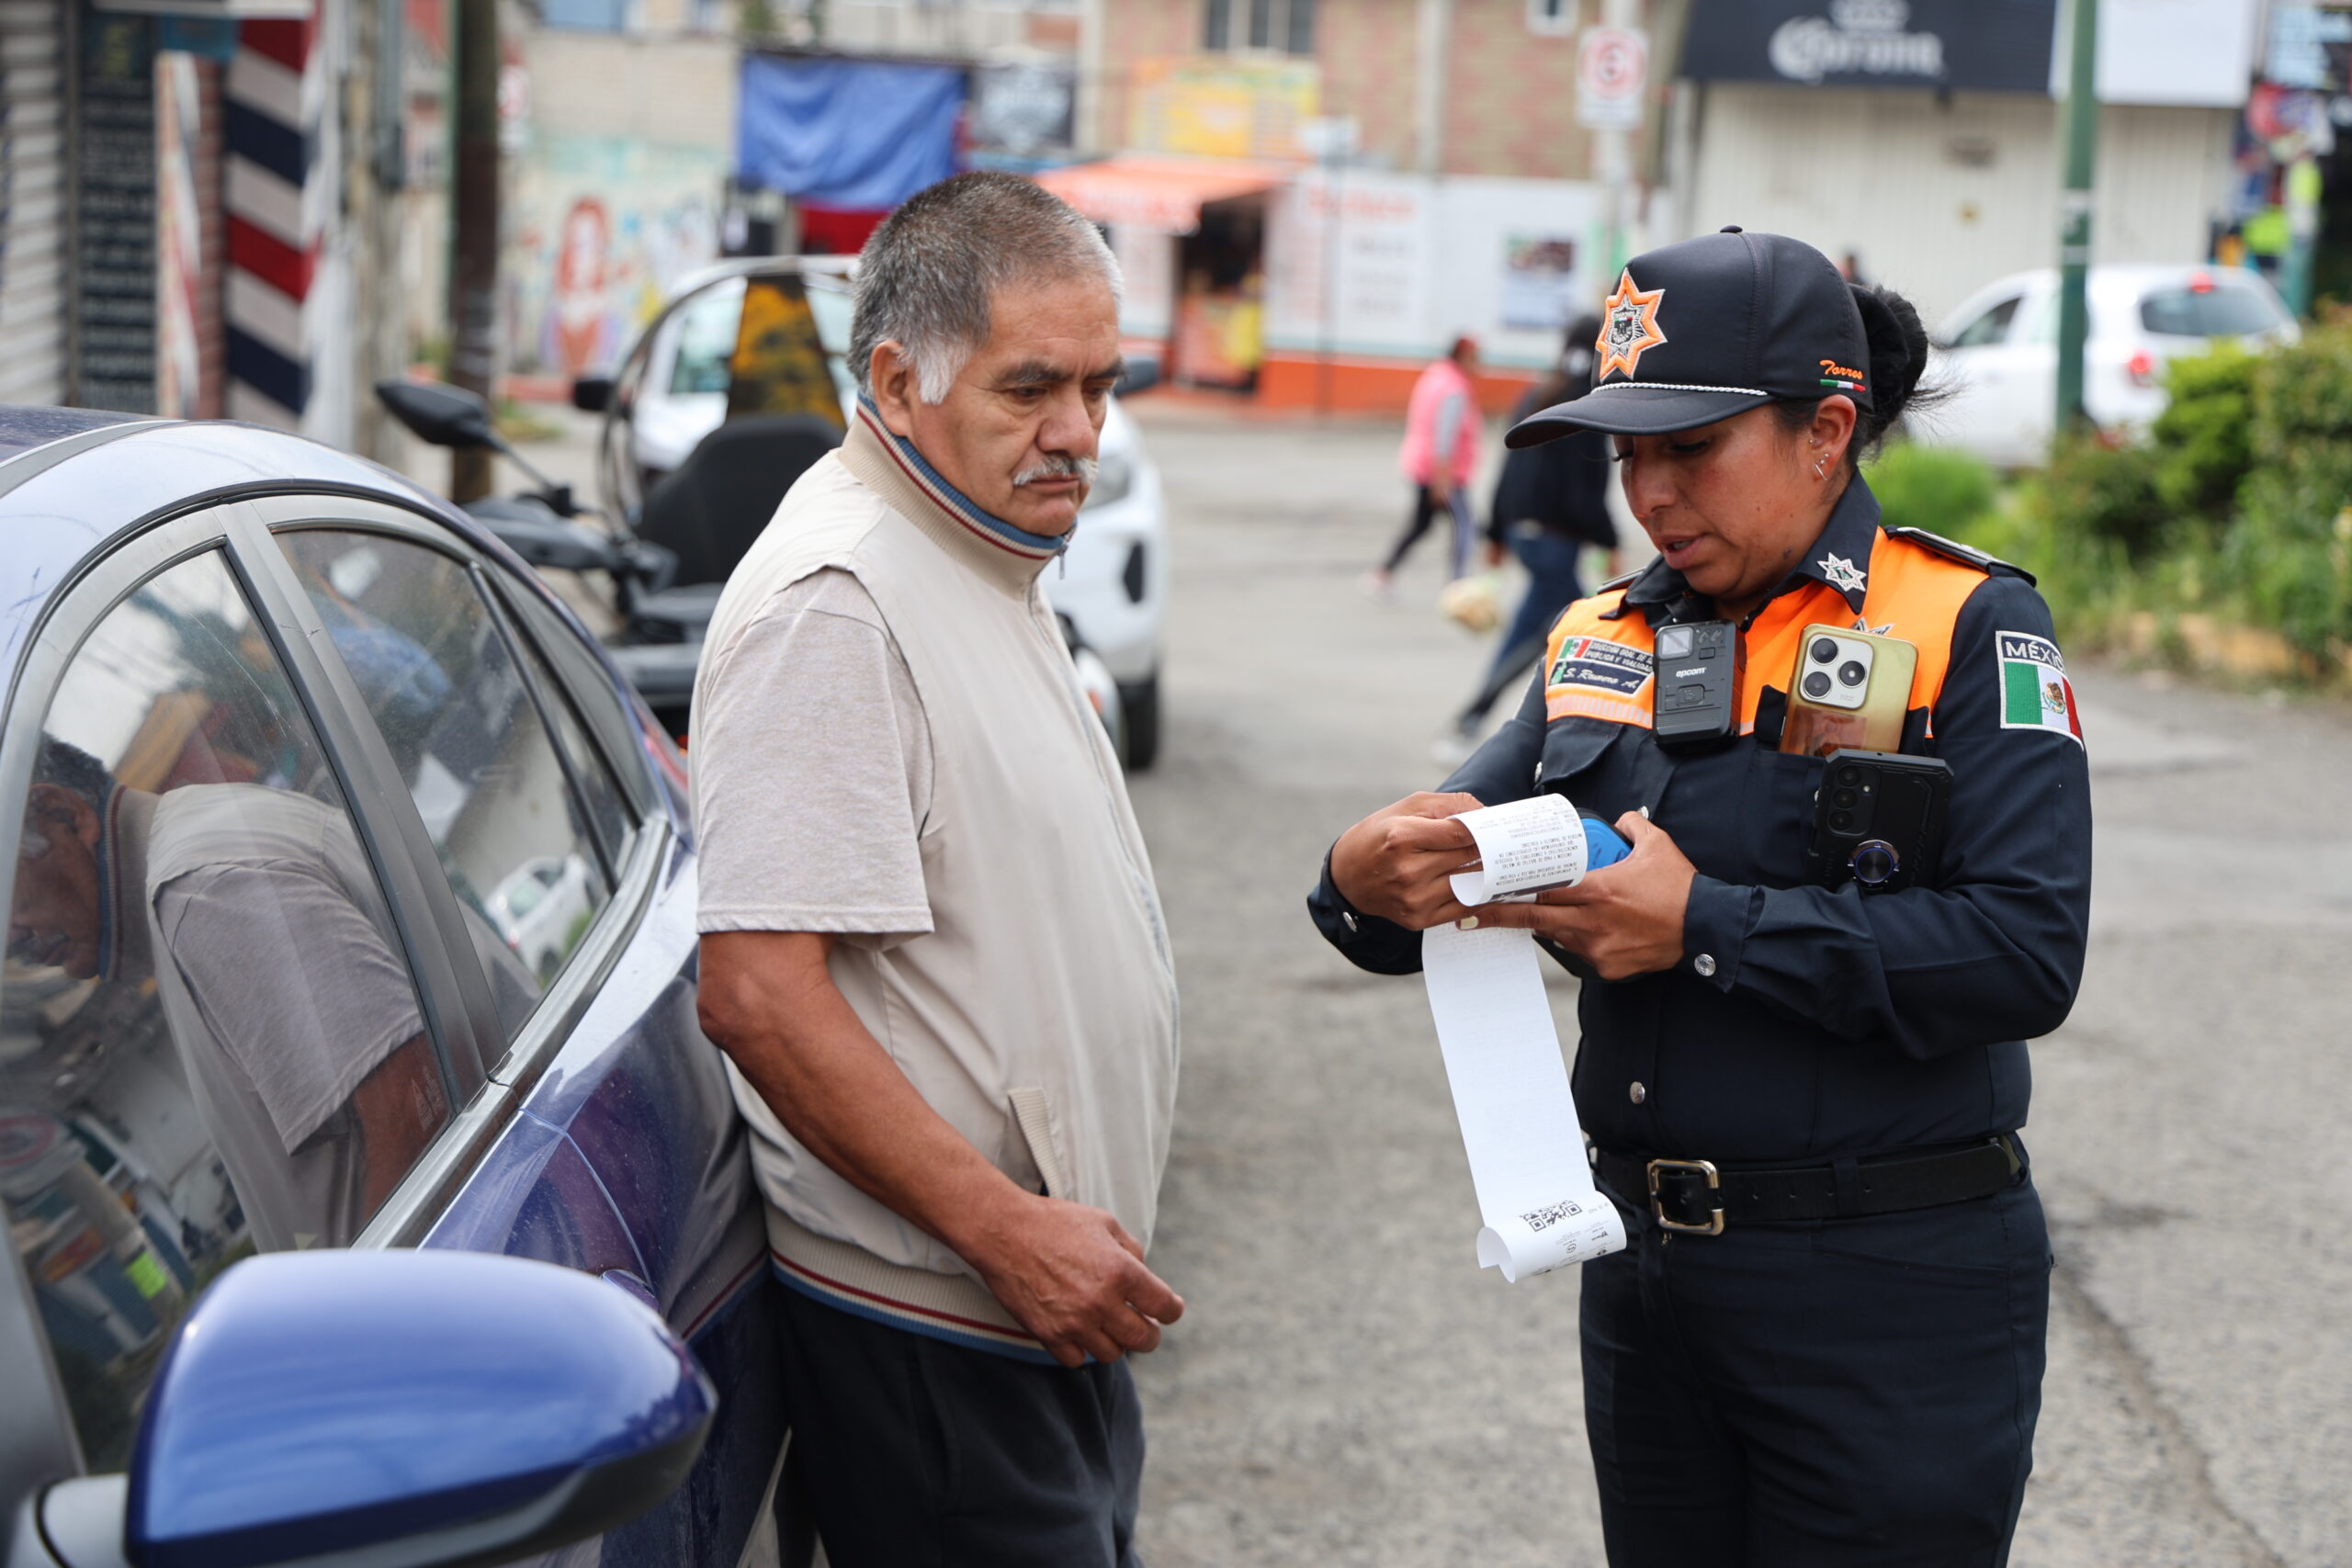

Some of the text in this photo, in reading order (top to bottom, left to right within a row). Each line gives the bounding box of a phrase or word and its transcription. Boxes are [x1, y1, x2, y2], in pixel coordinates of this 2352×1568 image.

[1768, 16, 1946, 85] Corona
[1819, 359, 1863, 379] Torres
[2005, 640, 2064, 672] MÉXIC
